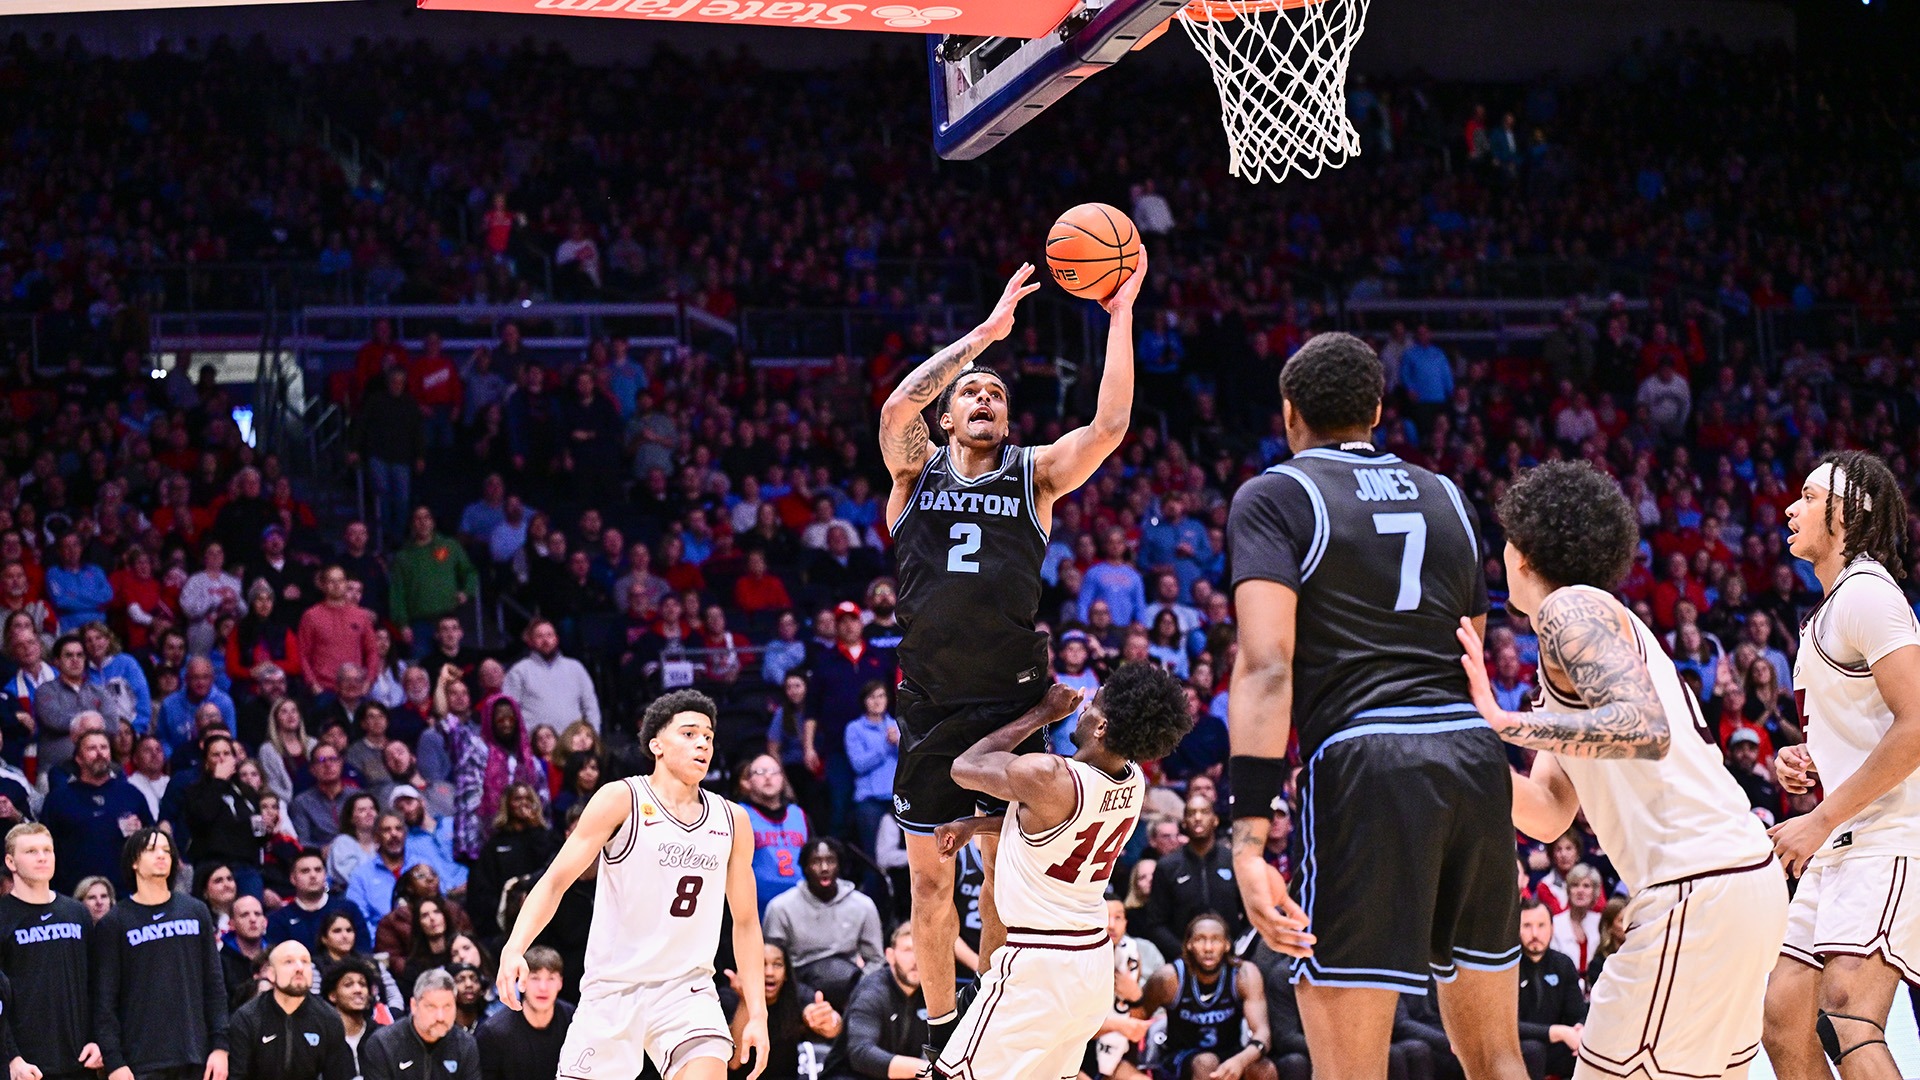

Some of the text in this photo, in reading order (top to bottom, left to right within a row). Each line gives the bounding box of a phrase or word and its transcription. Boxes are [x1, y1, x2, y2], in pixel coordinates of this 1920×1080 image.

[1352, 468, 1420, 501] JONES
[919, 490, 1020, 517] DAYTON
[947, 522, 982, 573] 2
[1372, 512, 1427, 611] 7
[1099, 785, 1137, 813] REESE
[776, 849, 795, 877] 2
[1045, 816, 1136, 884] 14
[670, 875, 704, 917] 8
[15, 922, 82, 945] DAYTON
[126, 919, 200, 946] DAYTON
[1200, 1027, 1218, 1047] 3
